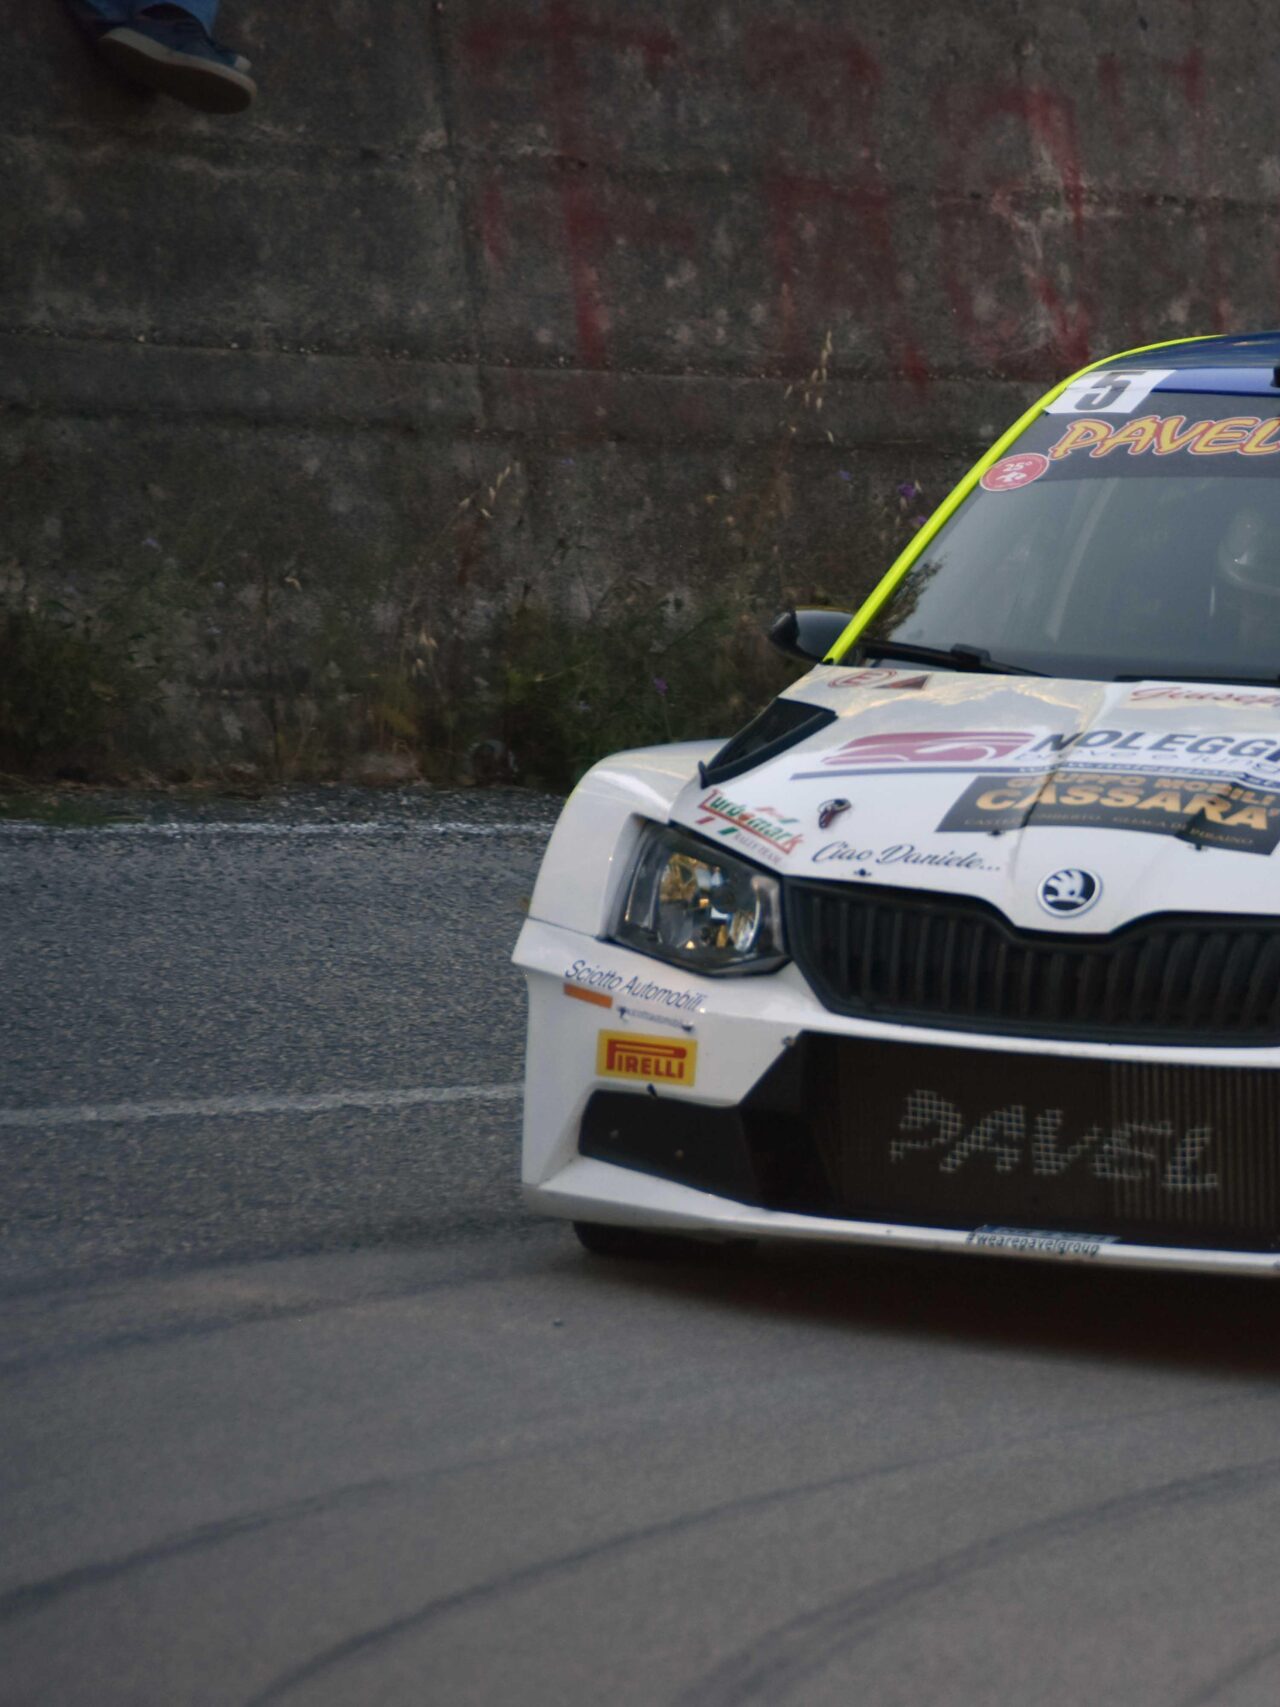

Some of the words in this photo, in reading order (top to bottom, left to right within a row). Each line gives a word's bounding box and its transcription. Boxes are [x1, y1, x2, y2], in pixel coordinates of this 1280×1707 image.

[1074, 370, 1146, 411] 5
[1154, 778, 1277, 806] MOBILI
[810, 840, 873, 864] Ciao
[564, 958, 622, 993] Sciotto
[623, 975, 708, 1012] Automobili
[605, 1038, 688, 1080] PIRELLI
[889, 1088, 1218, 1192] PAVEL
